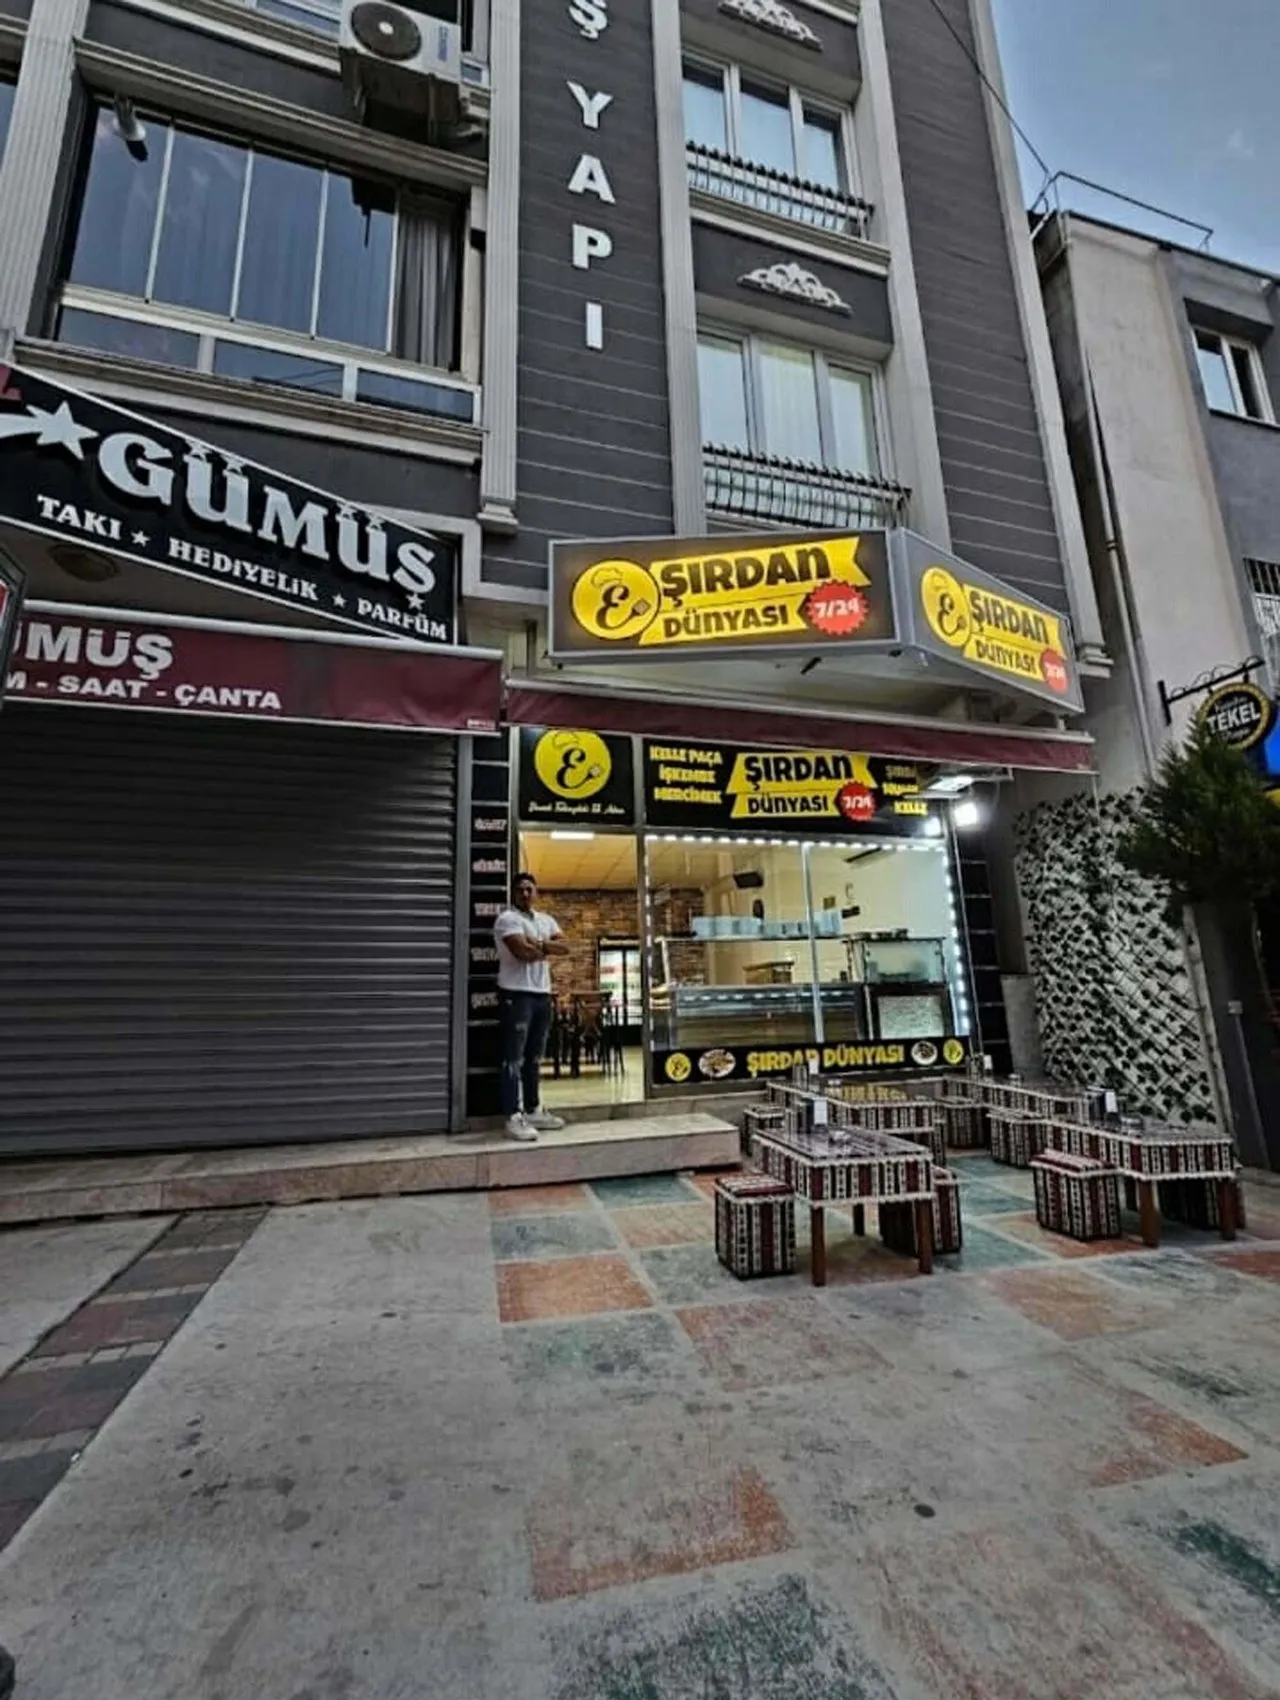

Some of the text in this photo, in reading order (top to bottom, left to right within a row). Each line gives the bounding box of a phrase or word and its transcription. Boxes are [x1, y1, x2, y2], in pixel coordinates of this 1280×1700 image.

[566, 79, 616, 351] YAPI
[99, 432, 436, 610] GÜMÜŞ
[37, 494, 121, 541] TAKI
[357, 599, 447, 641] PARFÜM
[660, 546, 831, 607] ŞIRDAN
[663, 598, 860, 639] DÜNYASI 7/24
[969, 591, 1050, 645] ŞIRDAN
[13, 621, 174, 680] MÜŞ
[57, 675, 147, 699] SAAT
[175, 684, 282, 711] ÇANTA
[1206, 701, 1261, 734] TEKEL
[744, 755, 854, 791] ŞIRDAN
[748, 792, 829, 814] DÜNYASI
[823, 1044, 905, 1068] DÜNYASI
